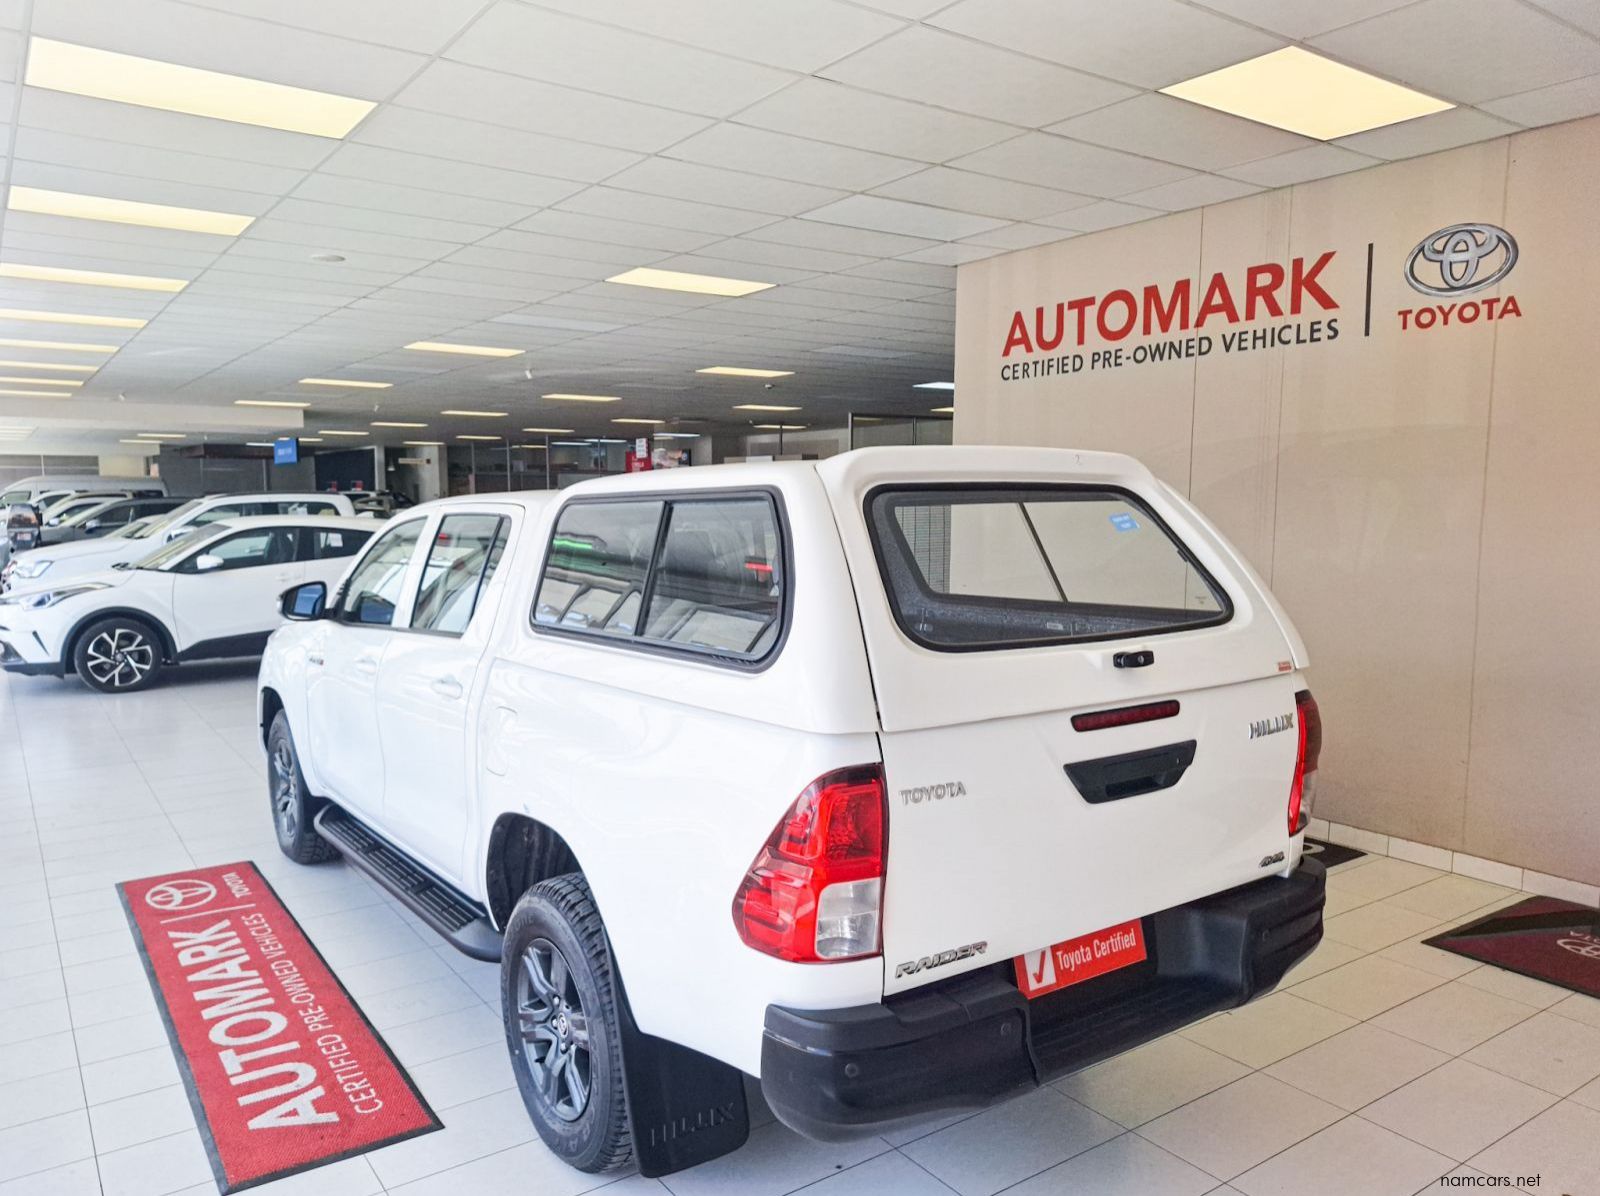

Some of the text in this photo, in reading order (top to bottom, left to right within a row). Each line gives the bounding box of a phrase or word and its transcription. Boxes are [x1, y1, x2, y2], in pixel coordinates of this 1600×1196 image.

[1002, 250, 1339, 358] AUTOMARK
[1397, 295, 1522, 331] TOYOTA
[1001, 318, 1340, 381] CERTIFIED PRE-OWNED VEHICLES
[1248, 712, 1294, 740] HILUX
[899, 781, 967, 805] TOYOTA
[221, 872, 253, 898] TOYOTA
[895, 940, 988, 979] RAIDER
[1056, 928, 1136, 971] Toyota Certified
[167, 919, 340, 1130] AUTOMARK
[240, 913, 383, 1114] CERTIFIED PRE-OWNED VEHICLES
